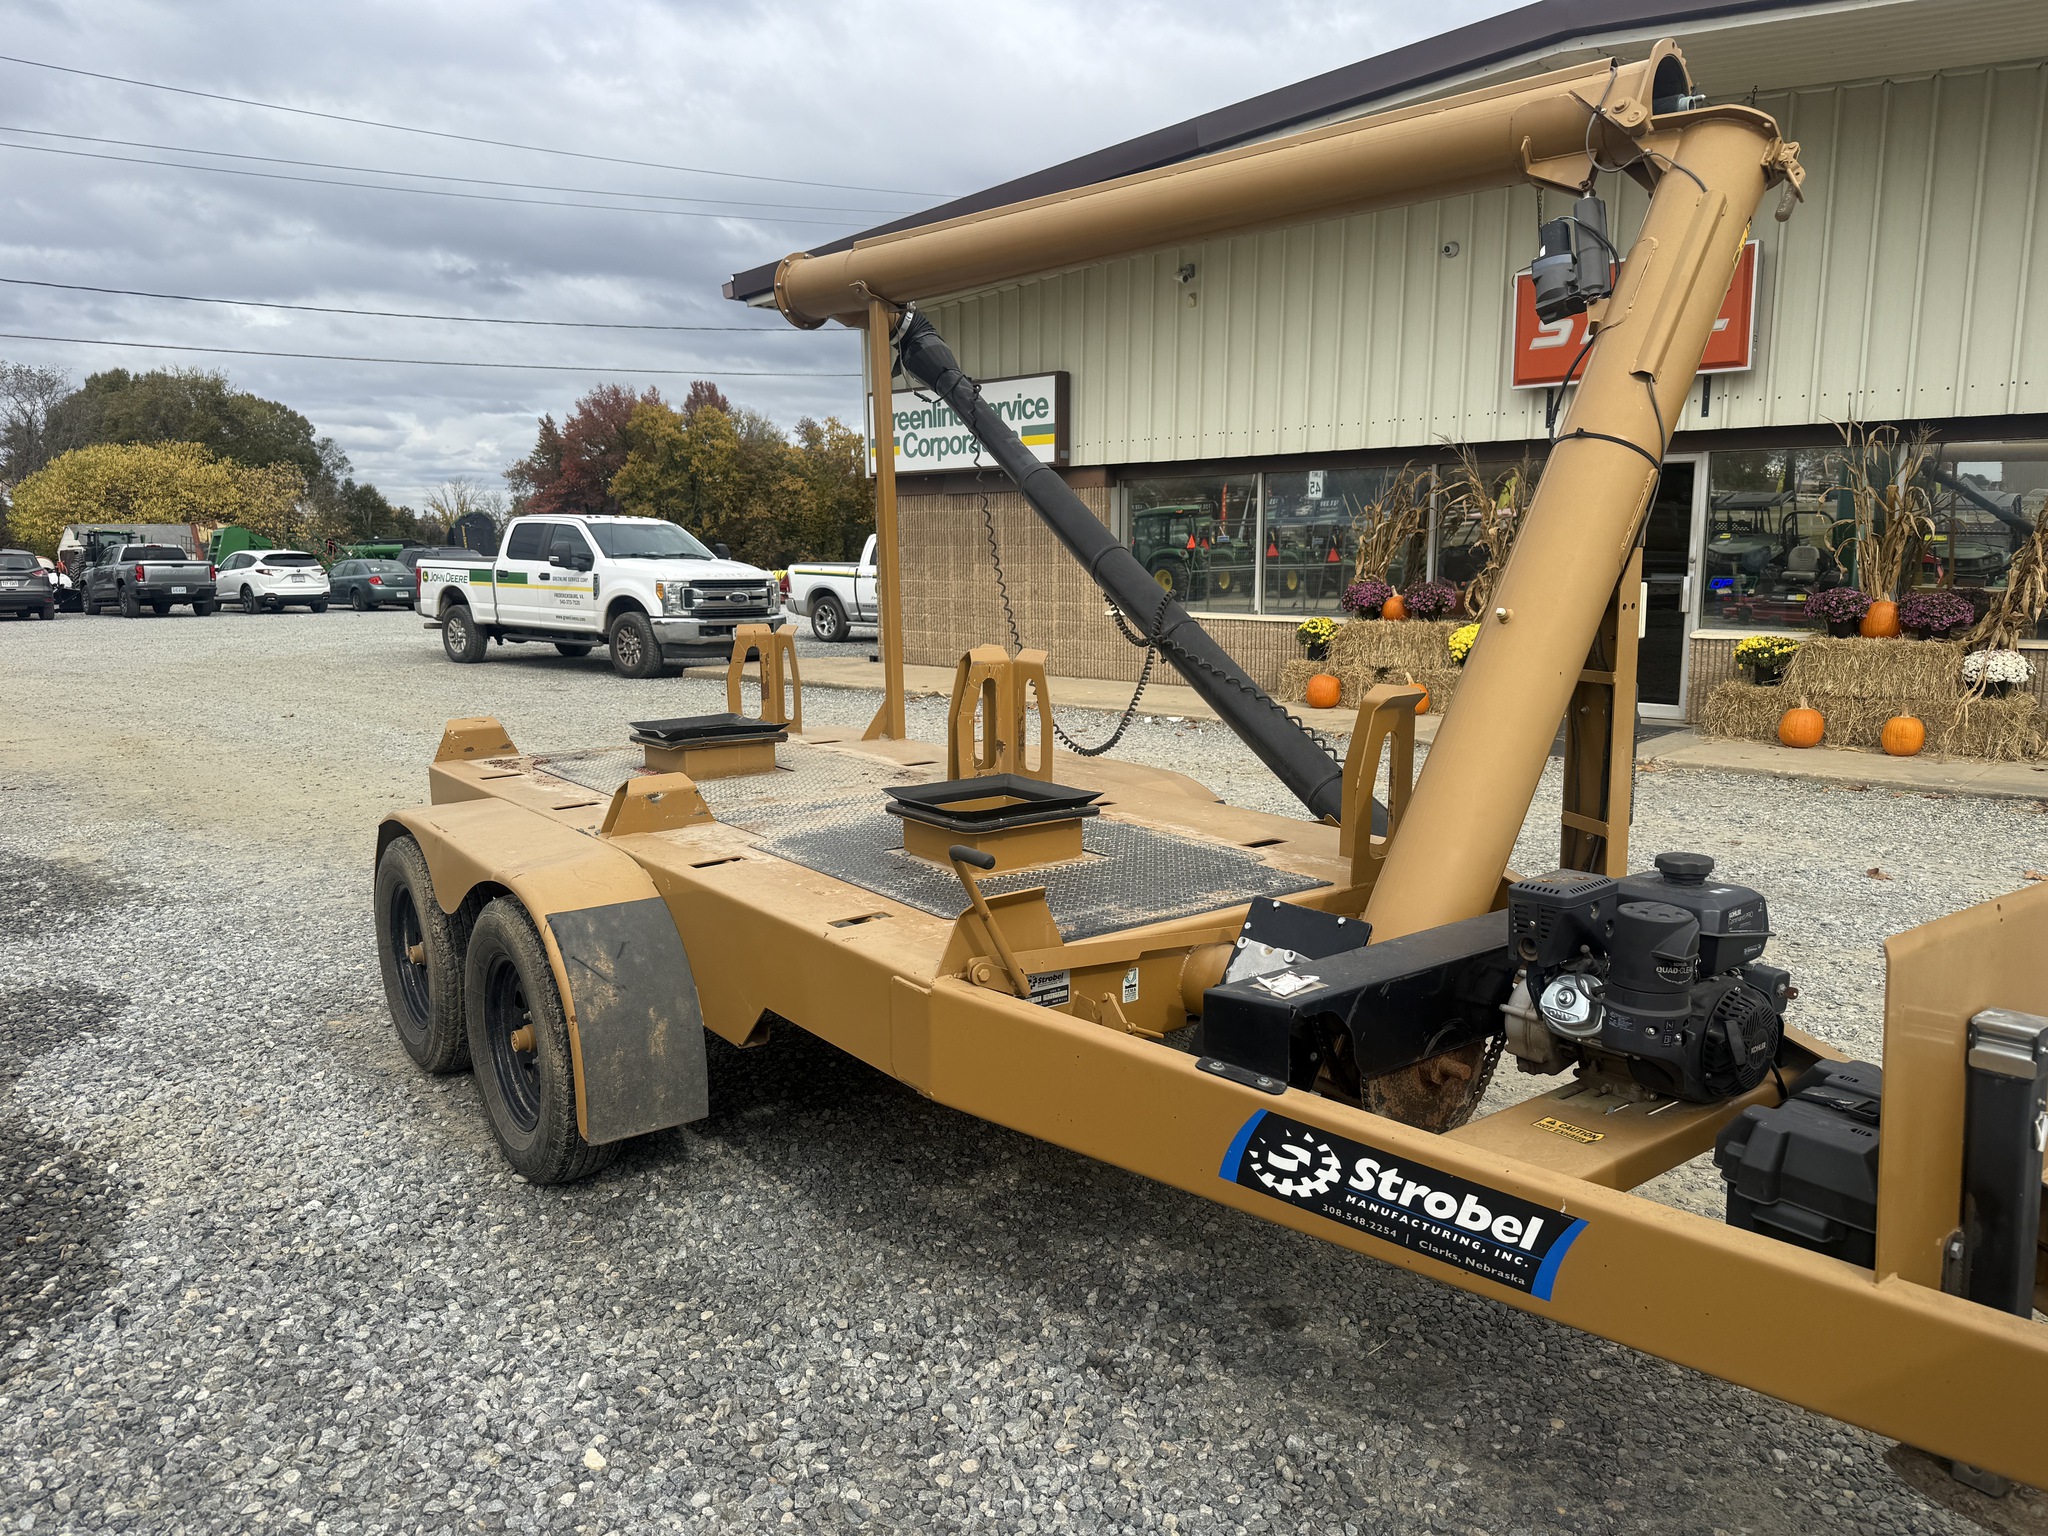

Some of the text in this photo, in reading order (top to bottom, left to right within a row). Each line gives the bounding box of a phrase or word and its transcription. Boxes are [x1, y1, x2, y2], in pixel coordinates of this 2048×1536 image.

[429, 571, 468, 584] JOHN DEERE
[1037, 972, 1064, 985] Strobel
[1750, 1041, 1767, 1054] KOHLER
[1558, 1123, 1600, 1140] CAUTION
[1348, 1157, 1545, 1251] Strobel
[1345, 1194, 1530, 1268] MANUFACTURING, INC.
[1320, 1202, 1526, 1286] 308.548.2254 Clarks, Nebraska
